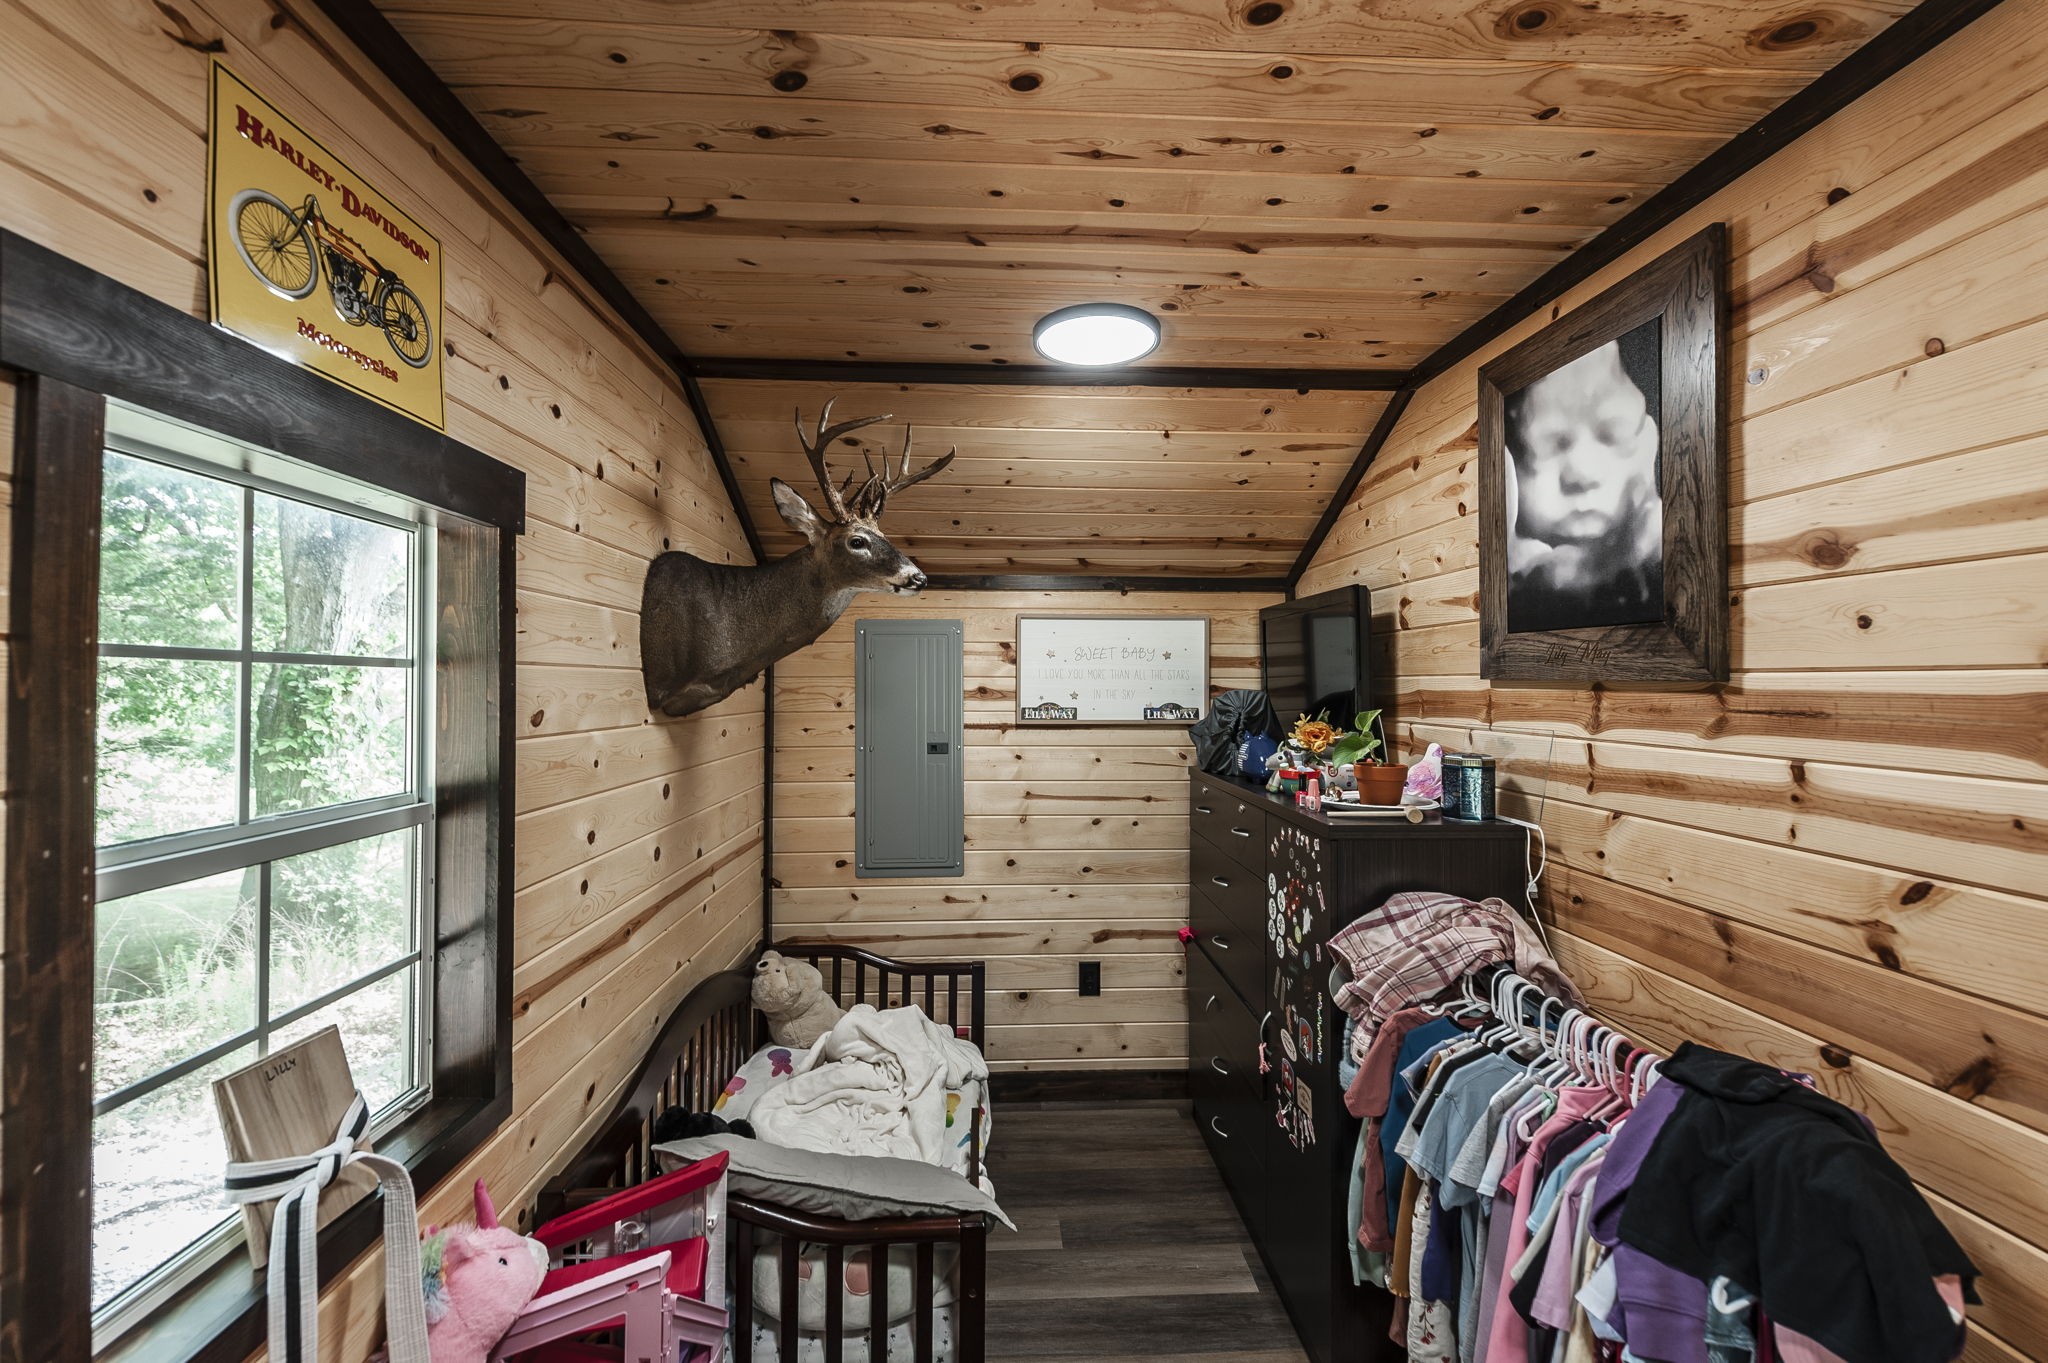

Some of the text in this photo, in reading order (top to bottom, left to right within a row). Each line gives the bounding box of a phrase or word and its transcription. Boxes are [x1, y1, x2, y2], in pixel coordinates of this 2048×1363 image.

[235, 104, 430, 265] HARLEY-DAVIDSON
[296, 316, 399, 383] Motorcycles
[1074, 646, 1155, 662] SWEET BABY
[1544, 640, 1611, 667] Lily May
[1044, 669, 1064, 680] LOVE
[1067, 669, 1083, 680] YOU
[1087, 669, 1105, 680] MORE
[1110, 669, 1130, 680] THAN
[1133, 669, 1146, 680] ALL
[1151, 669, 1164, 680] THE
[1167, 669, 1190, 680] STARS
[1093, 689, 1135, 700] IN THE SKY
[1051, 709, 1075, 719] WAY
[1146, 709, 1196, 719] LILY WAY
[265, 1058, 296, 1081] LILLY
